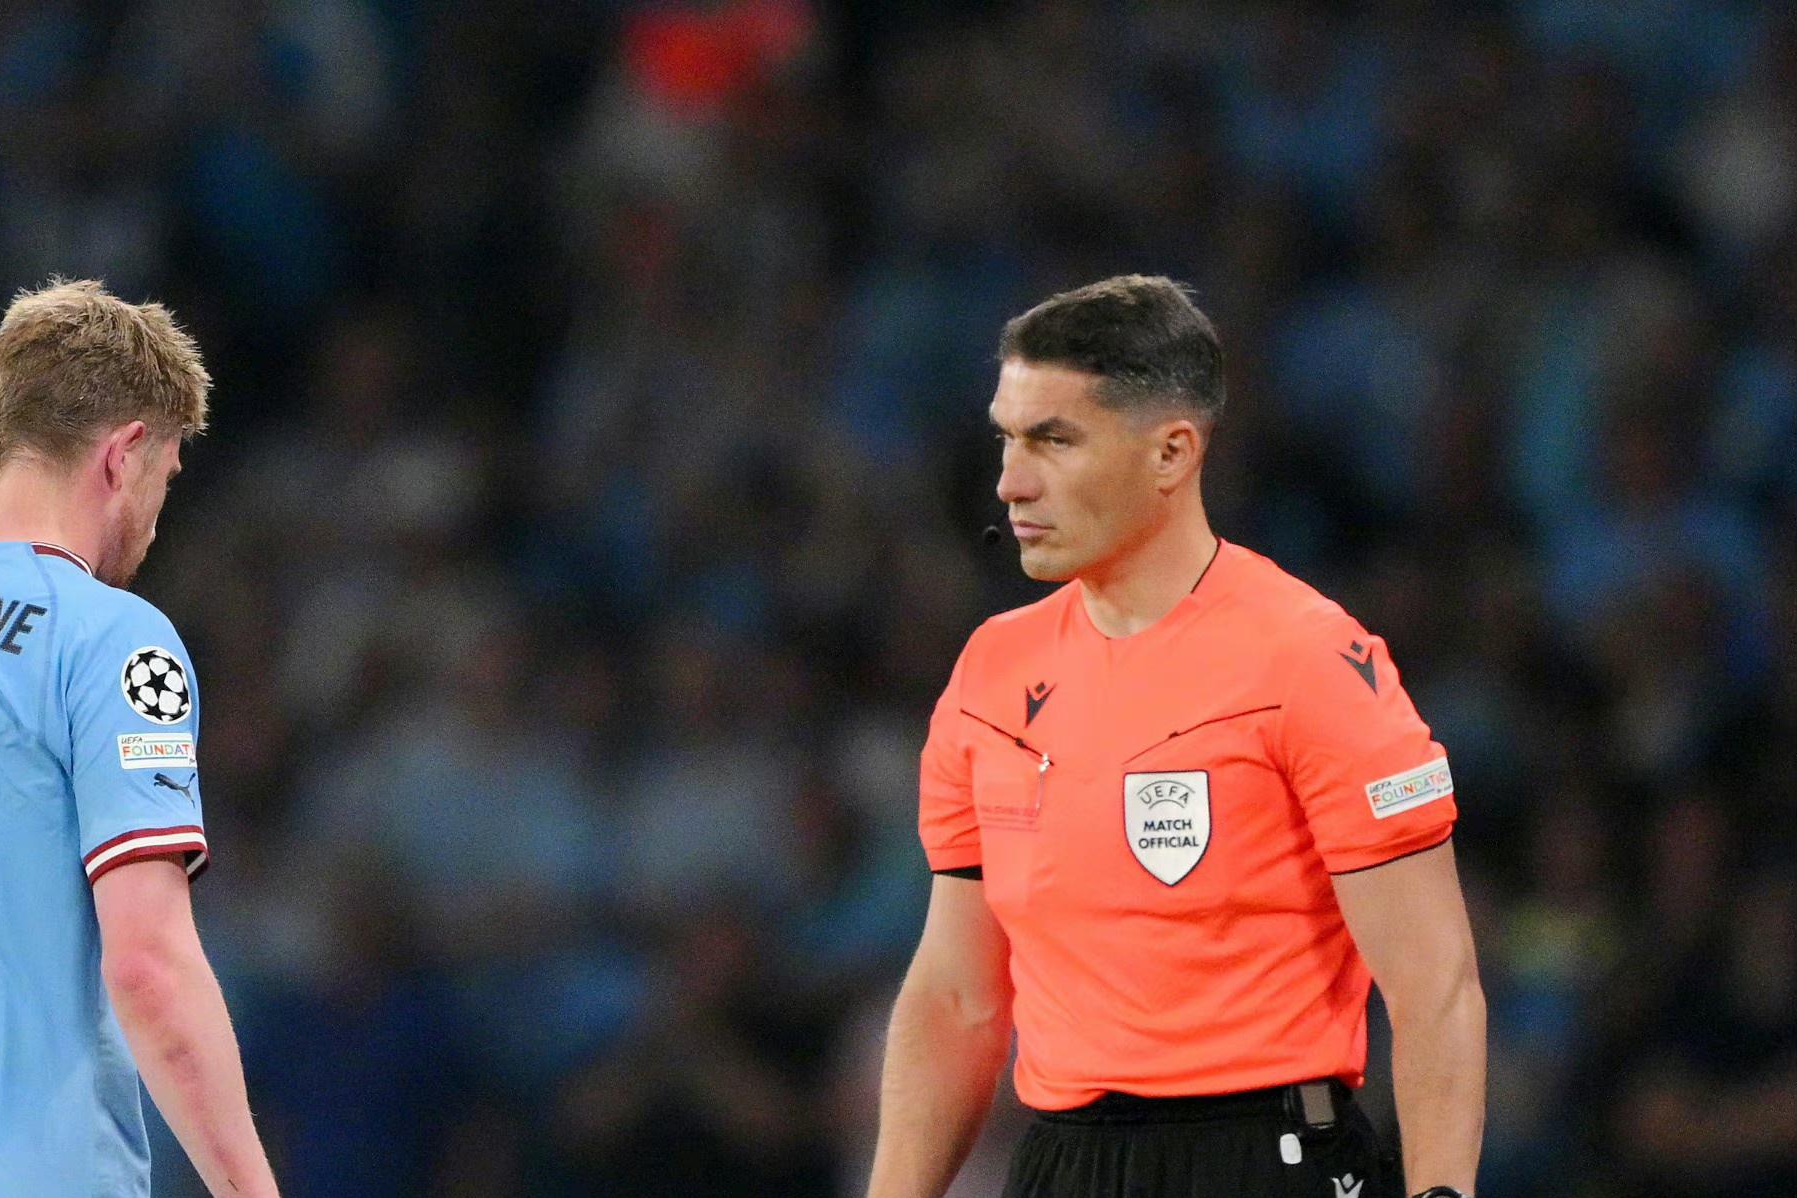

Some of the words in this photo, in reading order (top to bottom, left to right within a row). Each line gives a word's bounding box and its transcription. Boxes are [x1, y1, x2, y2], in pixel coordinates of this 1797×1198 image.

[121, 735, 143, 745] UEFA
[123, 744, 194, 757] FOUNDAT
[1139, 784, 1190, 804] UEFA
[1372, 770, 1449, 805] FOUNDATIO
[1143, 819, 1193, 832] MATCH
[1138, 836, 1200, 849] OFFICIAL
